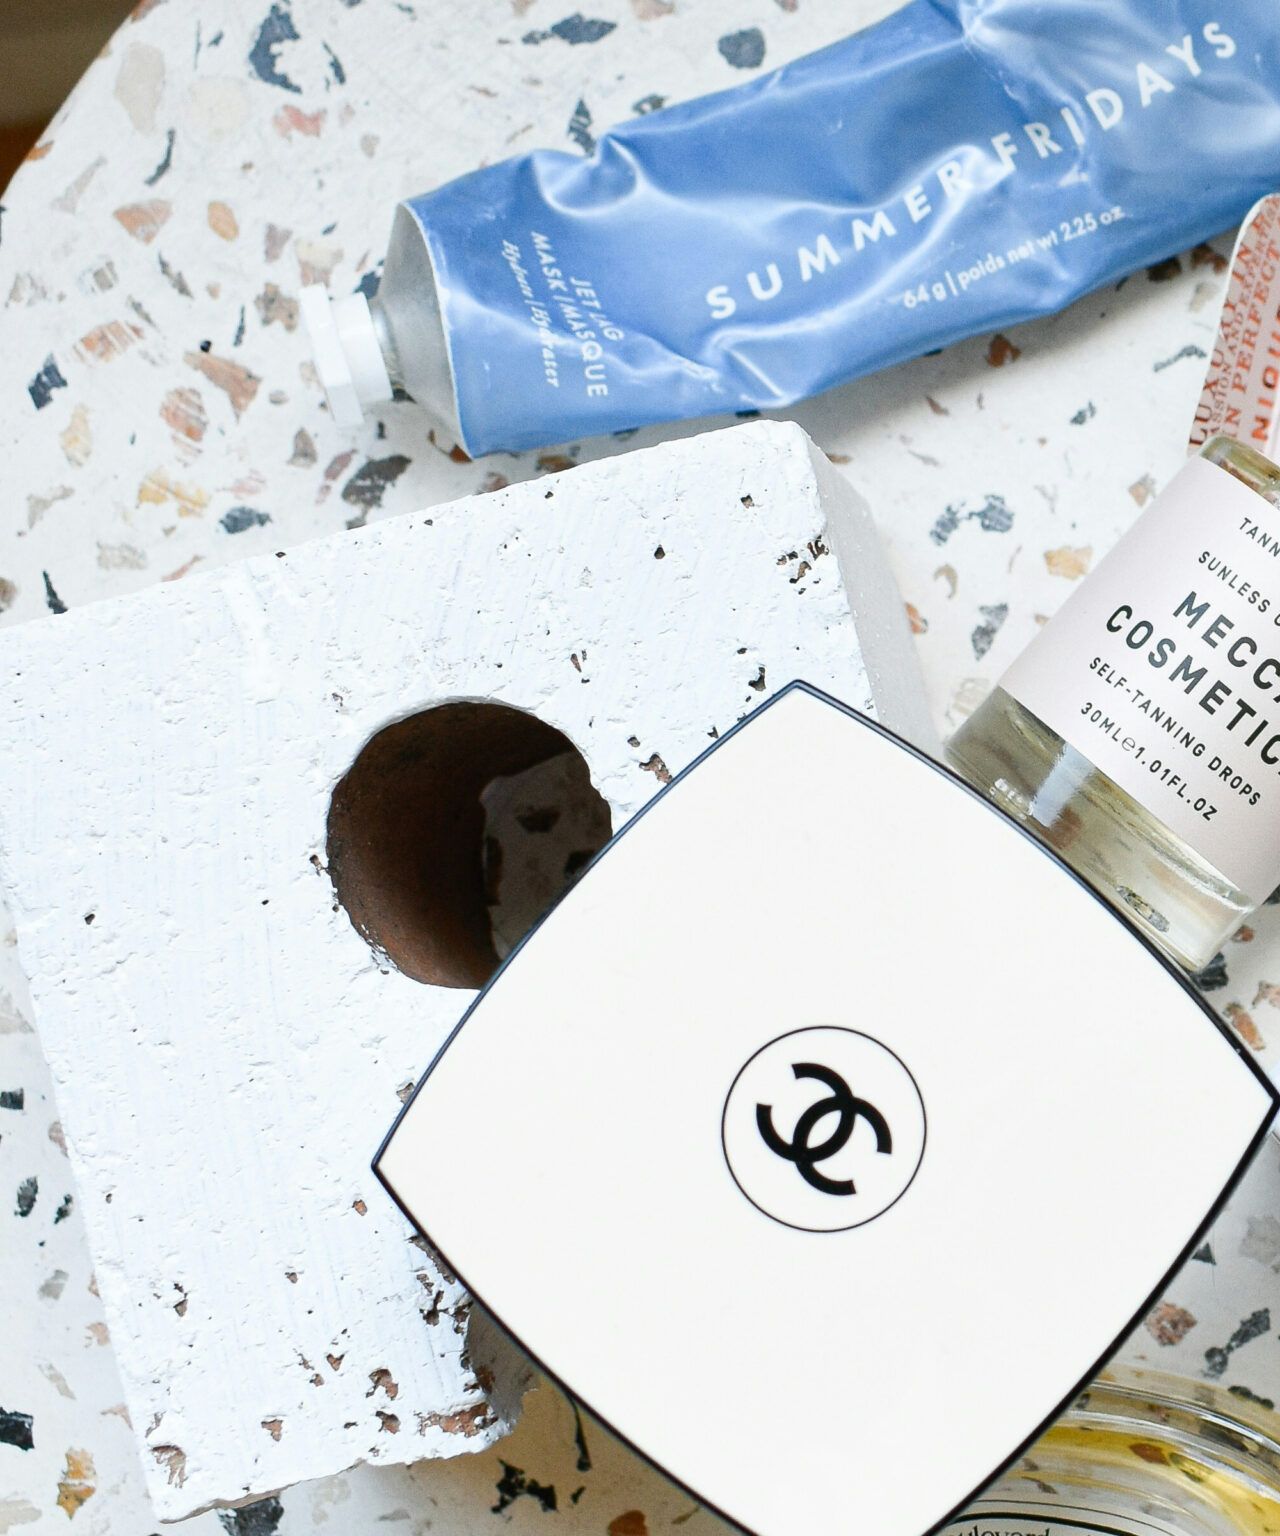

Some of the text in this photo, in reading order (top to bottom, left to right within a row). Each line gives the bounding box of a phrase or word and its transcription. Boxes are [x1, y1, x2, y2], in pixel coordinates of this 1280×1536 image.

[705, 21, 1238, 320] SUMMER FRIDAYS
[531, 231, 608, 398] MASK MASQUE
[570, 276, 625, 341] JET LAG
[903, 284, 929, 308] 64
[957, 253, 1005, 291] poids
[1099, 205, 1125, 226] oz
[1198, 551, 1271, 613] SUNLESS
[1089, 656, 1261, 806] SELF-TANNING DROPS
